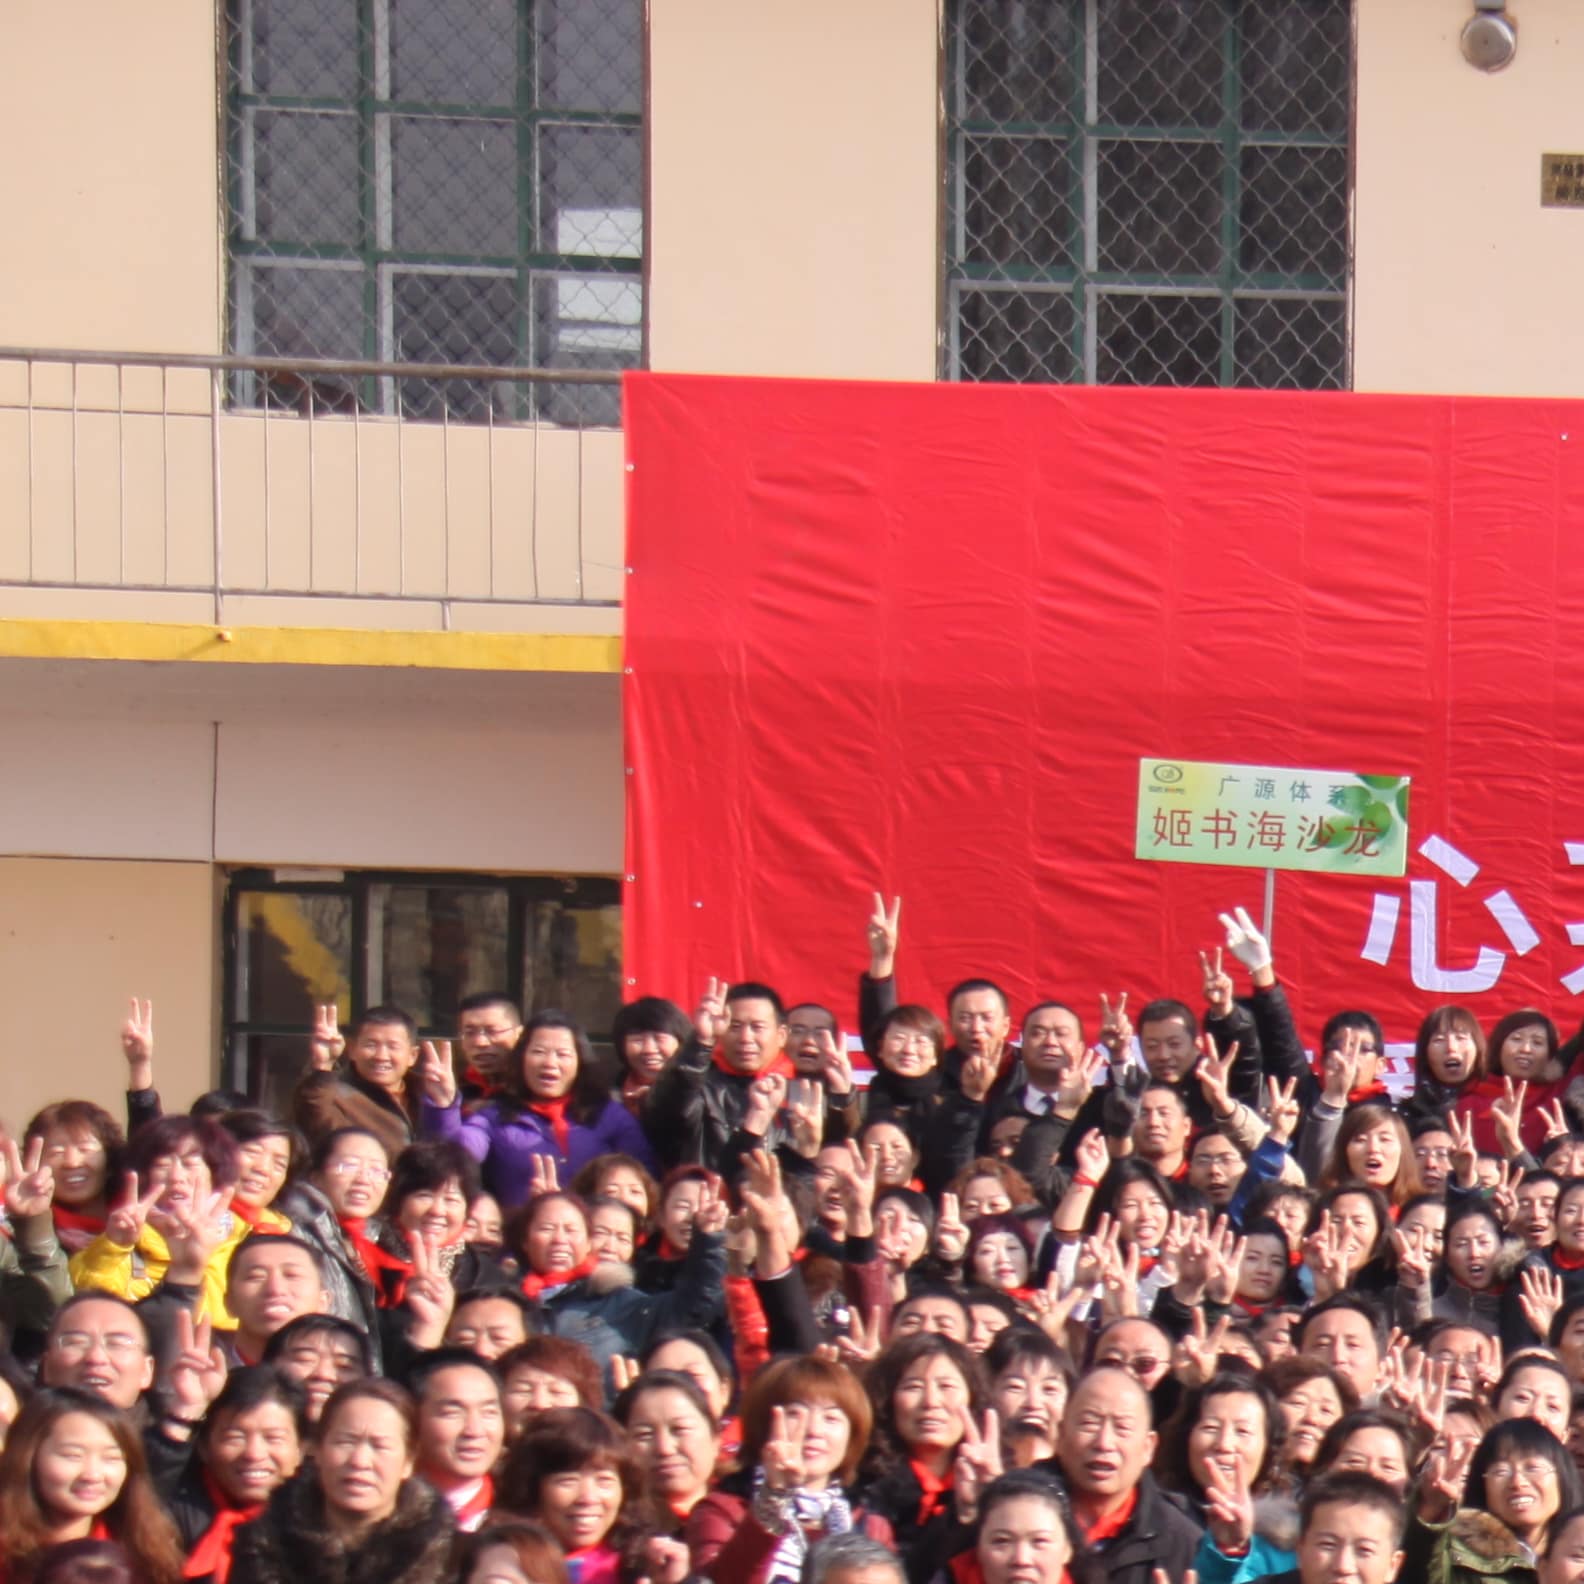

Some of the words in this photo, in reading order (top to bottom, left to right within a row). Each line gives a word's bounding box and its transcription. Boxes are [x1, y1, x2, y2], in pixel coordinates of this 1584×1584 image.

[1218, 775, 1347, 806] 广源体系
[1152, 805, 1382, 858] 姬书海沙龙
